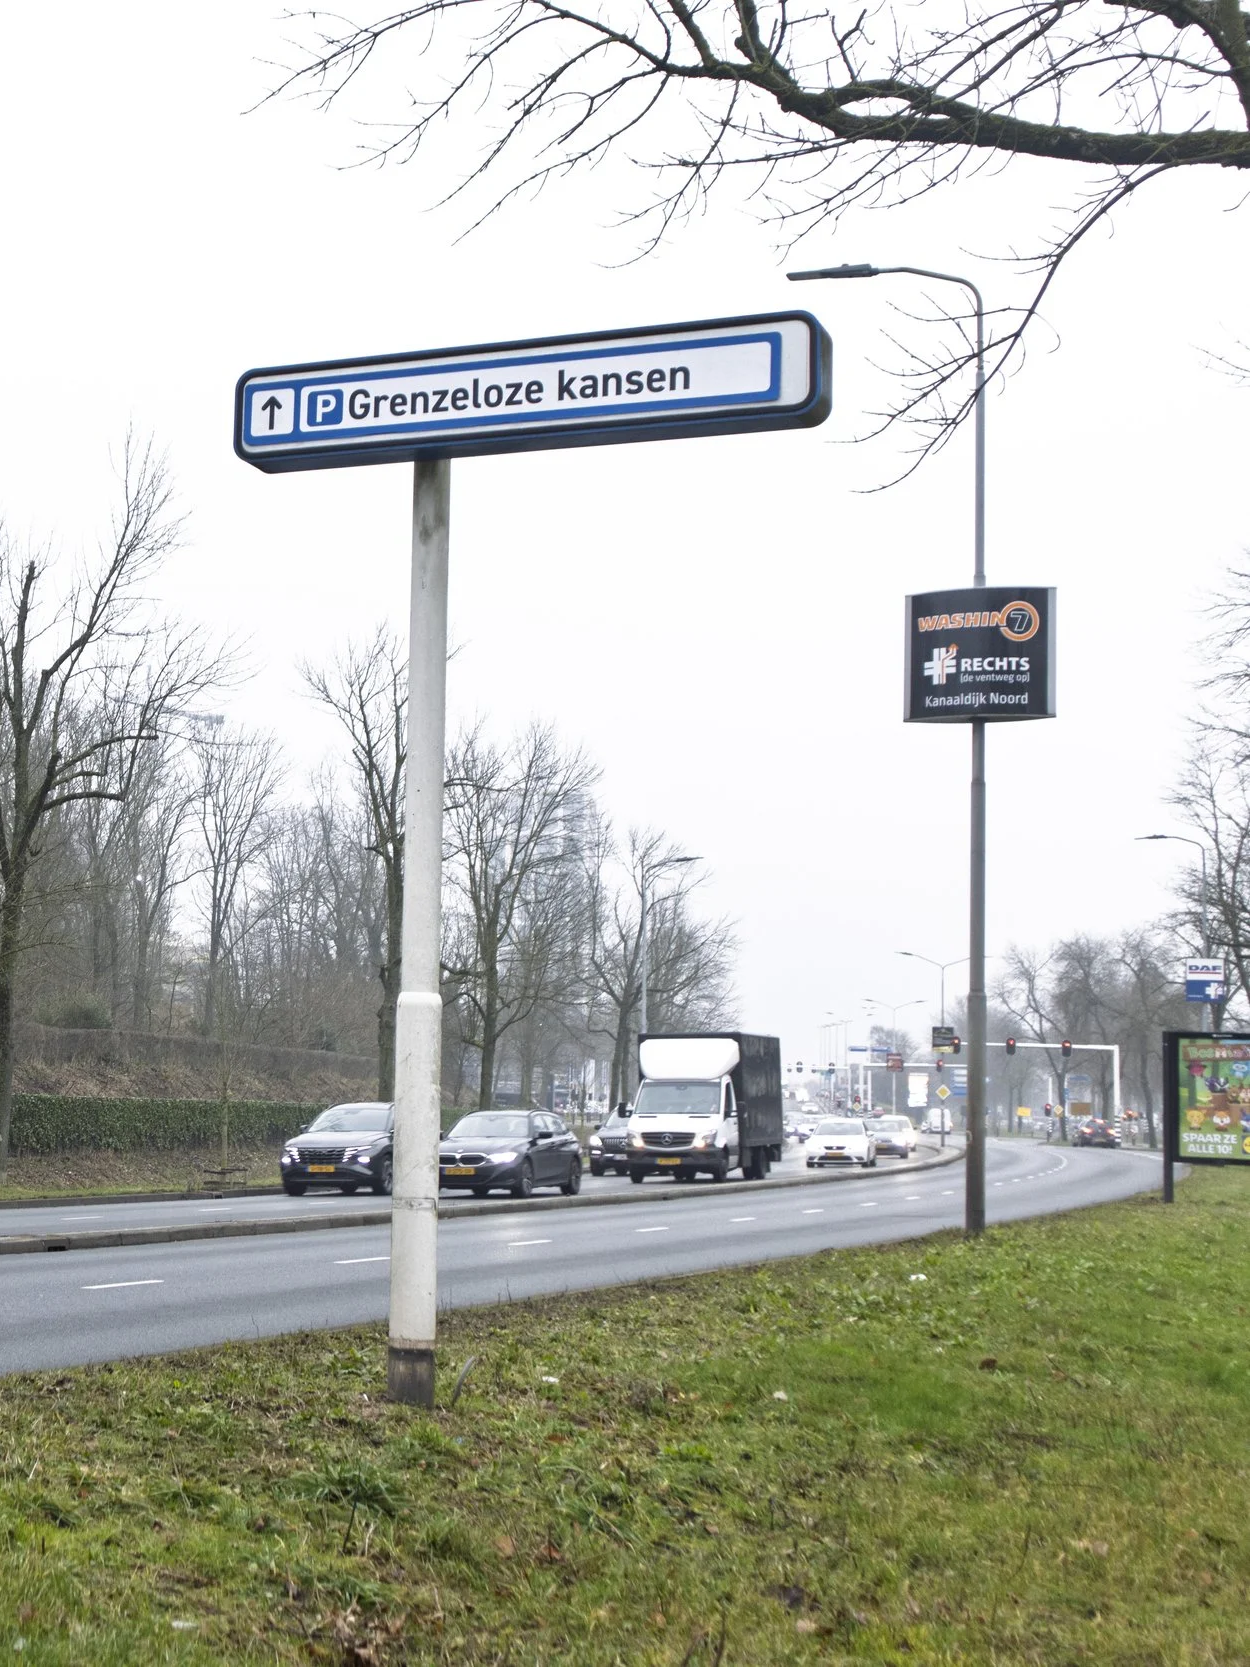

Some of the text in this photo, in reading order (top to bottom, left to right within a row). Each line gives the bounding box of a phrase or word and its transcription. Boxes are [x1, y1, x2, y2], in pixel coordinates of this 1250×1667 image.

[348, 378, 544, 420] Grenzeloze
[558, 366, 691, 401] kansen
[960, 657, 1030, 672] RECHTS
[975, 673, 1014, 684] ventweg
[925, 692, 1029, 708] Kanaaldijk Noord
[1188, 964, 1223, 972] DAF
[1182, 1132, 1238, 1145] SPAAR ZE
[1188, 1143, 1215, 1154] ALLE
